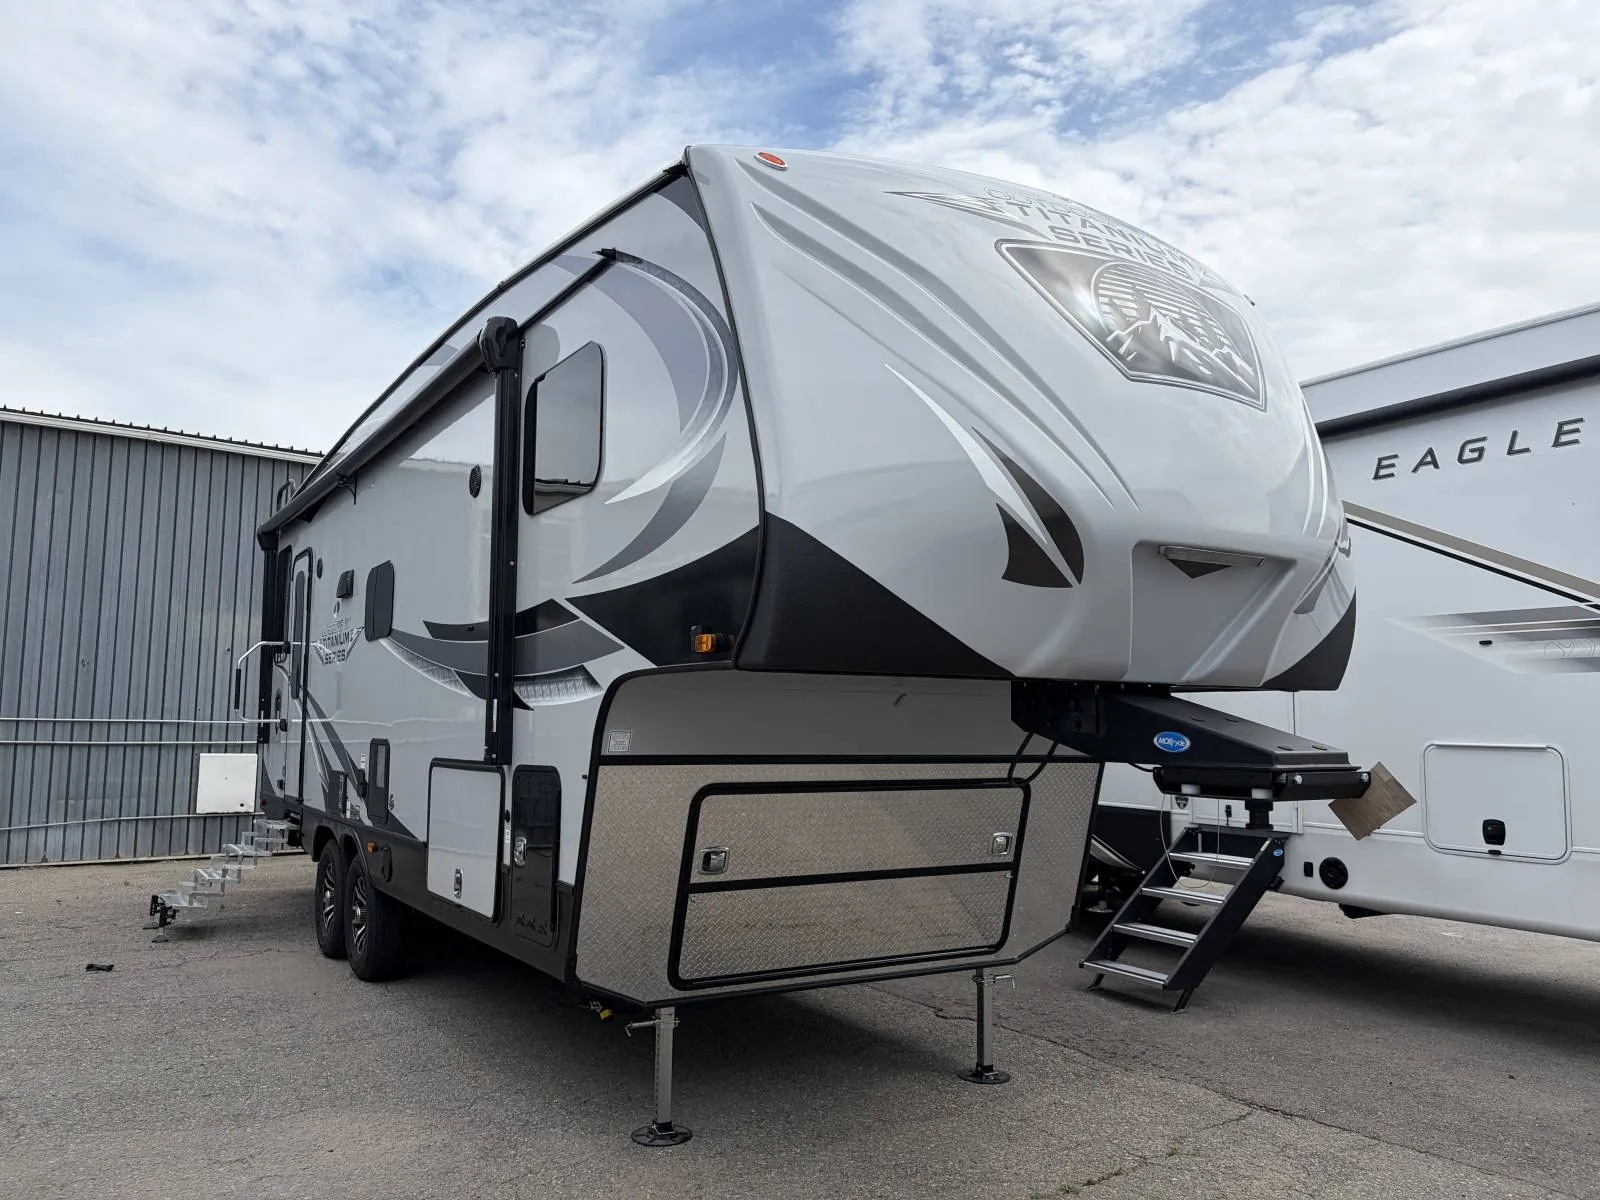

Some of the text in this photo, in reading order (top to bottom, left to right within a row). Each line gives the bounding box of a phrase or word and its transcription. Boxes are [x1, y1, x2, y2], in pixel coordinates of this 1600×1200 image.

[1005, 201, 1194, 271] TITANIUM
[1047, 225, 1193, 281] SERIES
[1372, 417, 1584, 480] EAGLE
